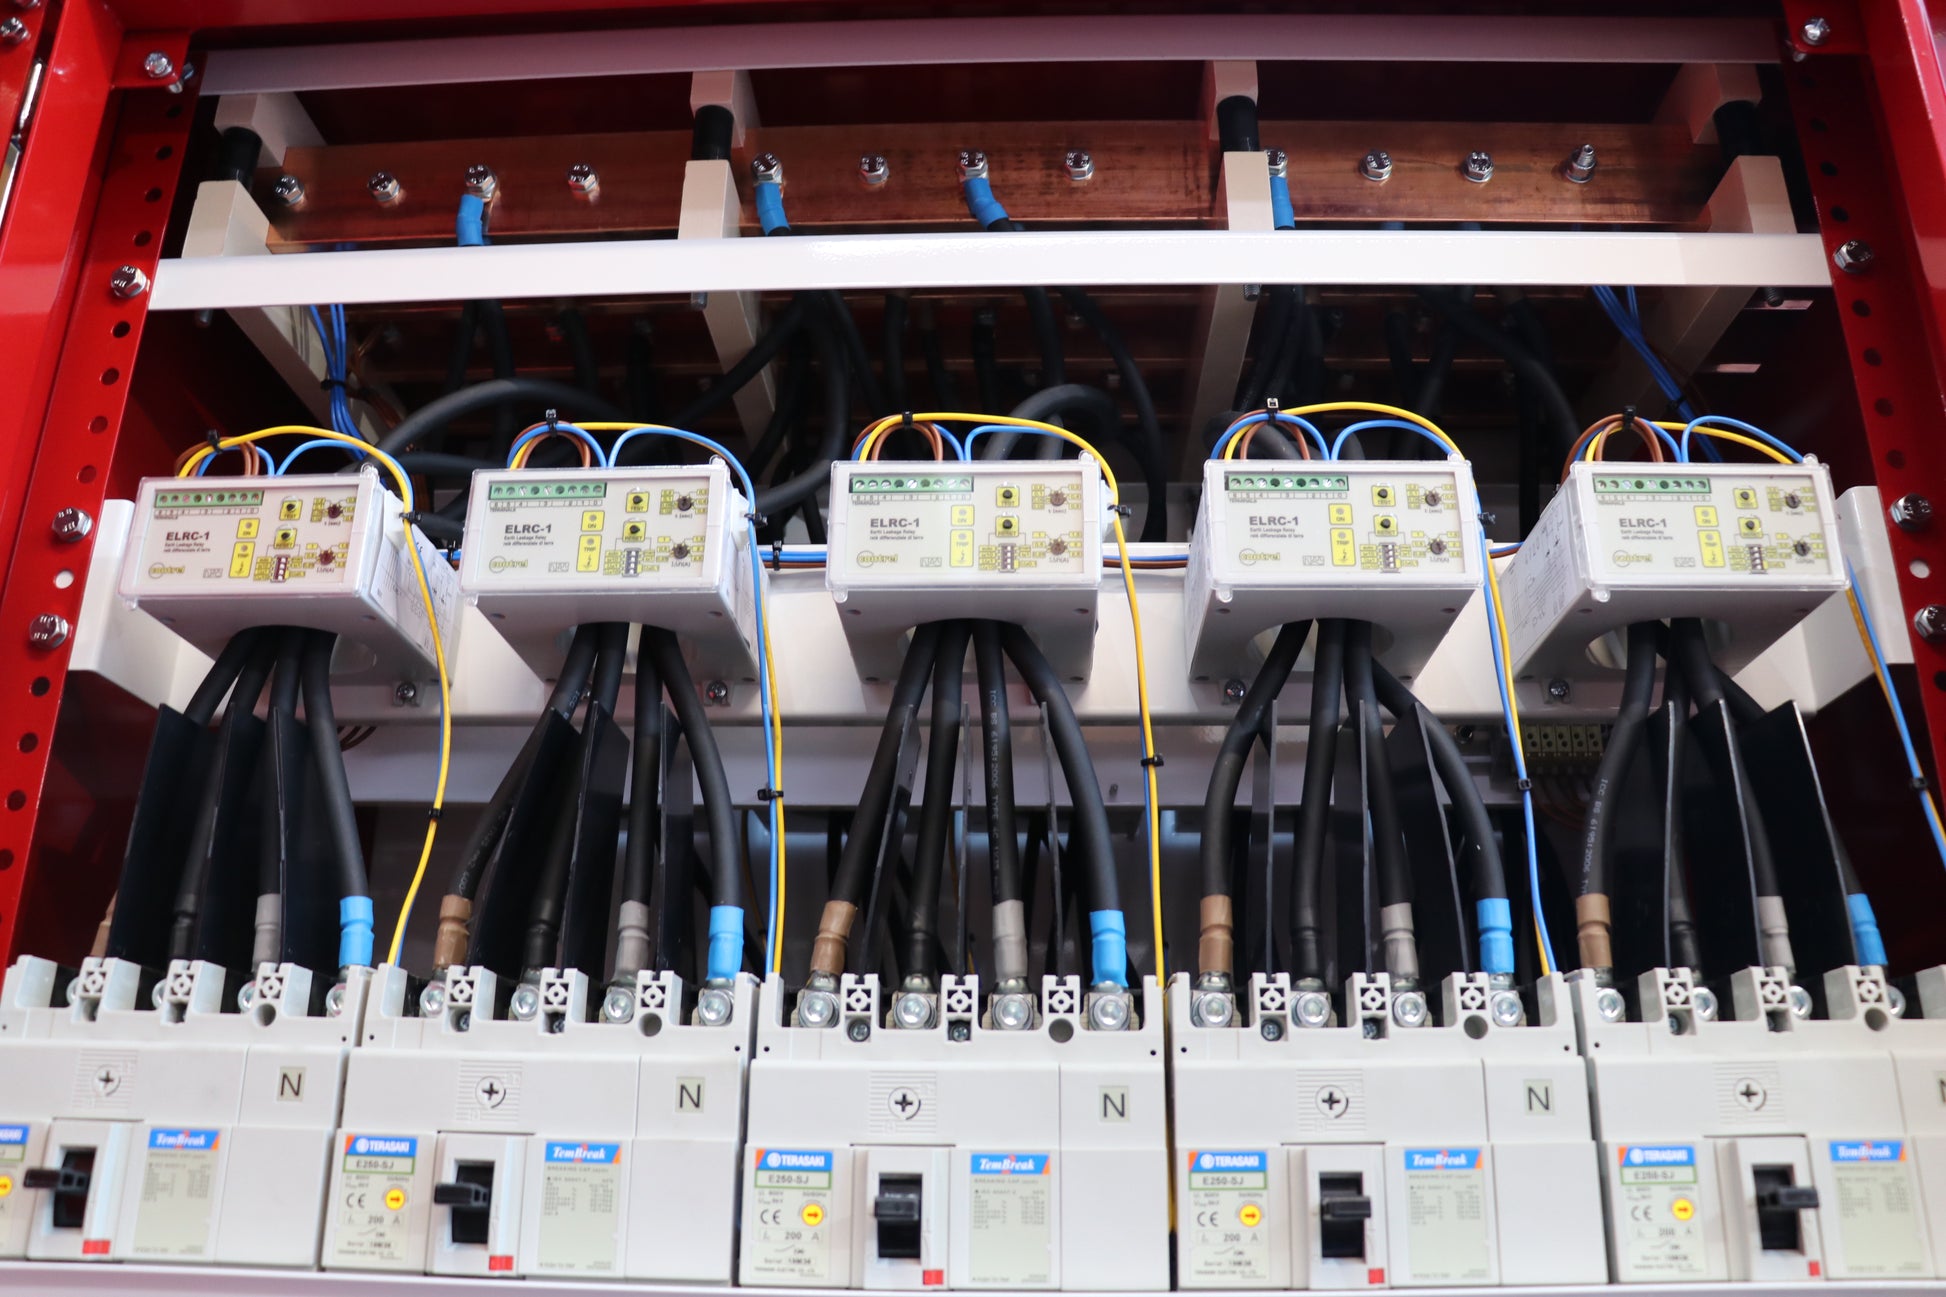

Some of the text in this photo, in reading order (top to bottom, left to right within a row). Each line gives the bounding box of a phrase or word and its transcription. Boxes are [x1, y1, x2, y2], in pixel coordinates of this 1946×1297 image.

[870, 518, 920, 528] ELRC-1
[1249, 516, 1299, 526] ELRC-1
[1619, 518, 1667, 528] ELRC-1
[505, 524, 552, 534] ELRC-1
[166, 531, 210, 541] ELRC-1
[281, 1072, 301, 1096] N
[680, 1084, 701, 1108] N
[1528, 1086, 1550, 1111] N
[1104, 1093, 1125, 1118] N
[157, 1132, 207, 1147] TemBreak
[370, 1140, 410, 1153] TERASAKI
[553, 1146, 606, 1160] TemBreak
[356, 1160, 395, 1170] E250-SJ
[781, 1155, 825, 1167] TERASAKI
[980, 1157, 1035, 1171] TemBreak
[1215, 1155, 1259, 1167] TERASAKI
[1413, 1153, 1468, 1166] TemBreak
[768, 1175, 809, 1184] E250-SJ
[1202, 1177, 1244, 1185] E250-SJ
[368, 1216, 384, 1225] 200
[785, 1231, 819, 1240] 200 A
[1223, 1233, 1258, 1242] 200 A
